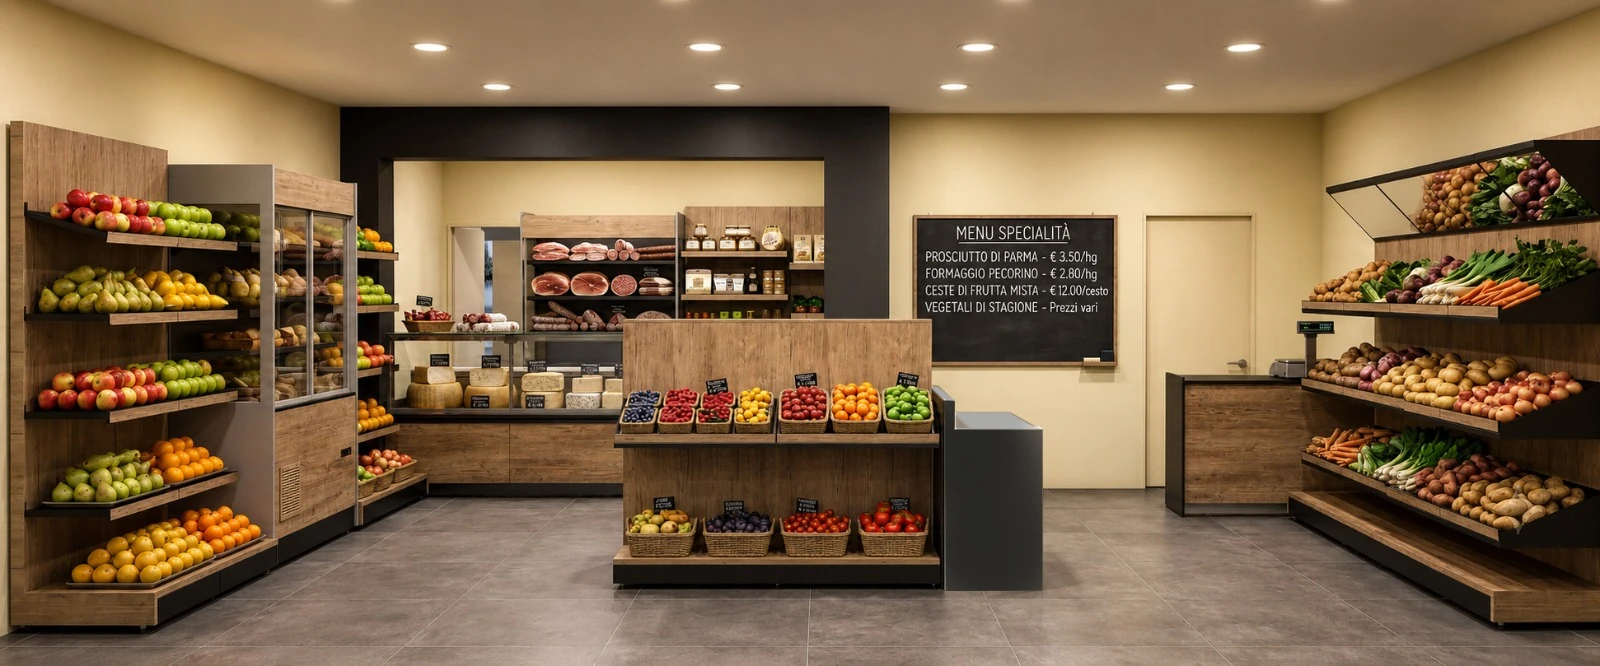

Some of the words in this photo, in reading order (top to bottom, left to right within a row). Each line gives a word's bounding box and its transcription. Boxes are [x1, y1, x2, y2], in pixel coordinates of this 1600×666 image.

[956, 225, 994, 240] MENU
[998, 222, 1071, 240] SPECIALITÀ
[925, 250, 988, 263] PROSCIUTTO
[990, 250, 1000, 263] DI
[1003, 250, 1038, 263] PARMA
[1049, 250, 1057, 263] €
[1059, 250, 1098, 266] 3.50/hg
[925, 267, 986, 279] FORMAGGIO
[988, 267, 1038, 279] PECORINO
[1049, 267, 1057, 279] €
[1059, 267, 1098, 282] 2.80/hg
[925, 284, 955, 296] CESTE
[957, 284, 967, 296] DI
[970, 284, 1007, 296] FRUTTA
[1010, 284, 1039, 296] MISTA
[1049, 284, 1056, 296] €
[1058, 284, 1109, 296] 12.00/cesto
[924, 301, 972, 313] VEGETALI
[975, 301, 986, 313] DI
[988, 301, 1038, 313] STAGIONE
[1049, 301, 1078, 313] Prezzi
[1080, 301, 1098, 313] vari
